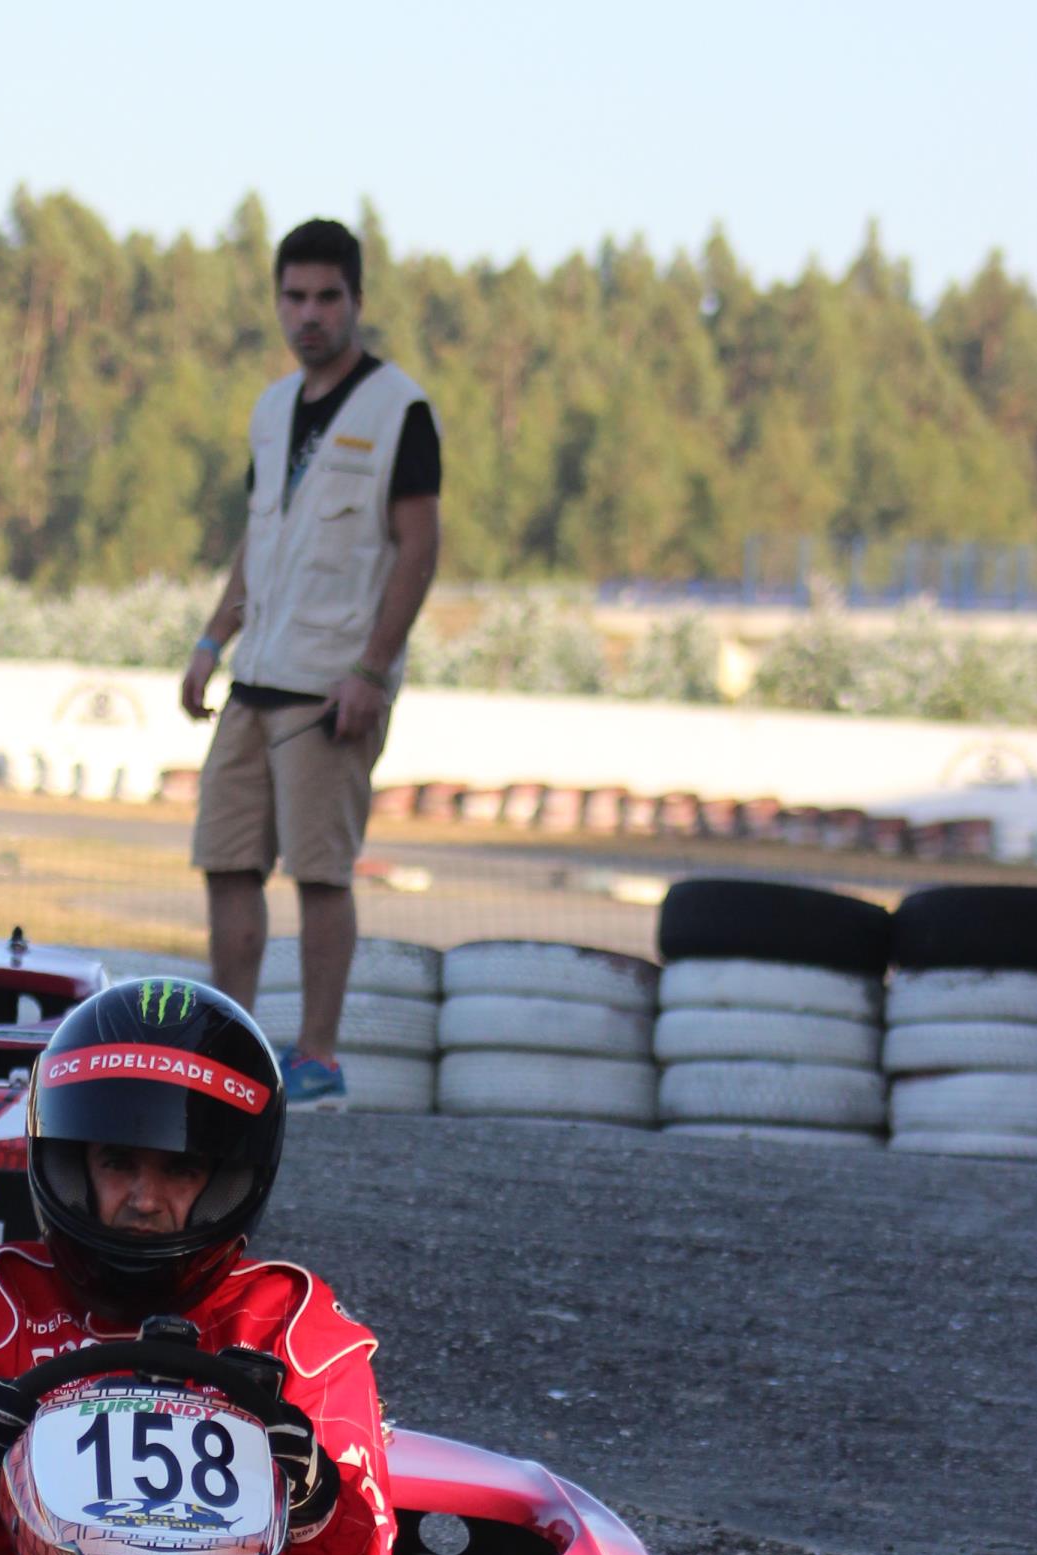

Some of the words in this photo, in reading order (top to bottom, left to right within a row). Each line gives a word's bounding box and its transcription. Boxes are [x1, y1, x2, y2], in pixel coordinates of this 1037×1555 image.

[89, 1053, 214, 1085] FIDELIDADE
[78, 1400, 219, 1421] EUROINDY
[76, 1412, 240, 1508] 158
[104, 1500, 192, 1521] 24
